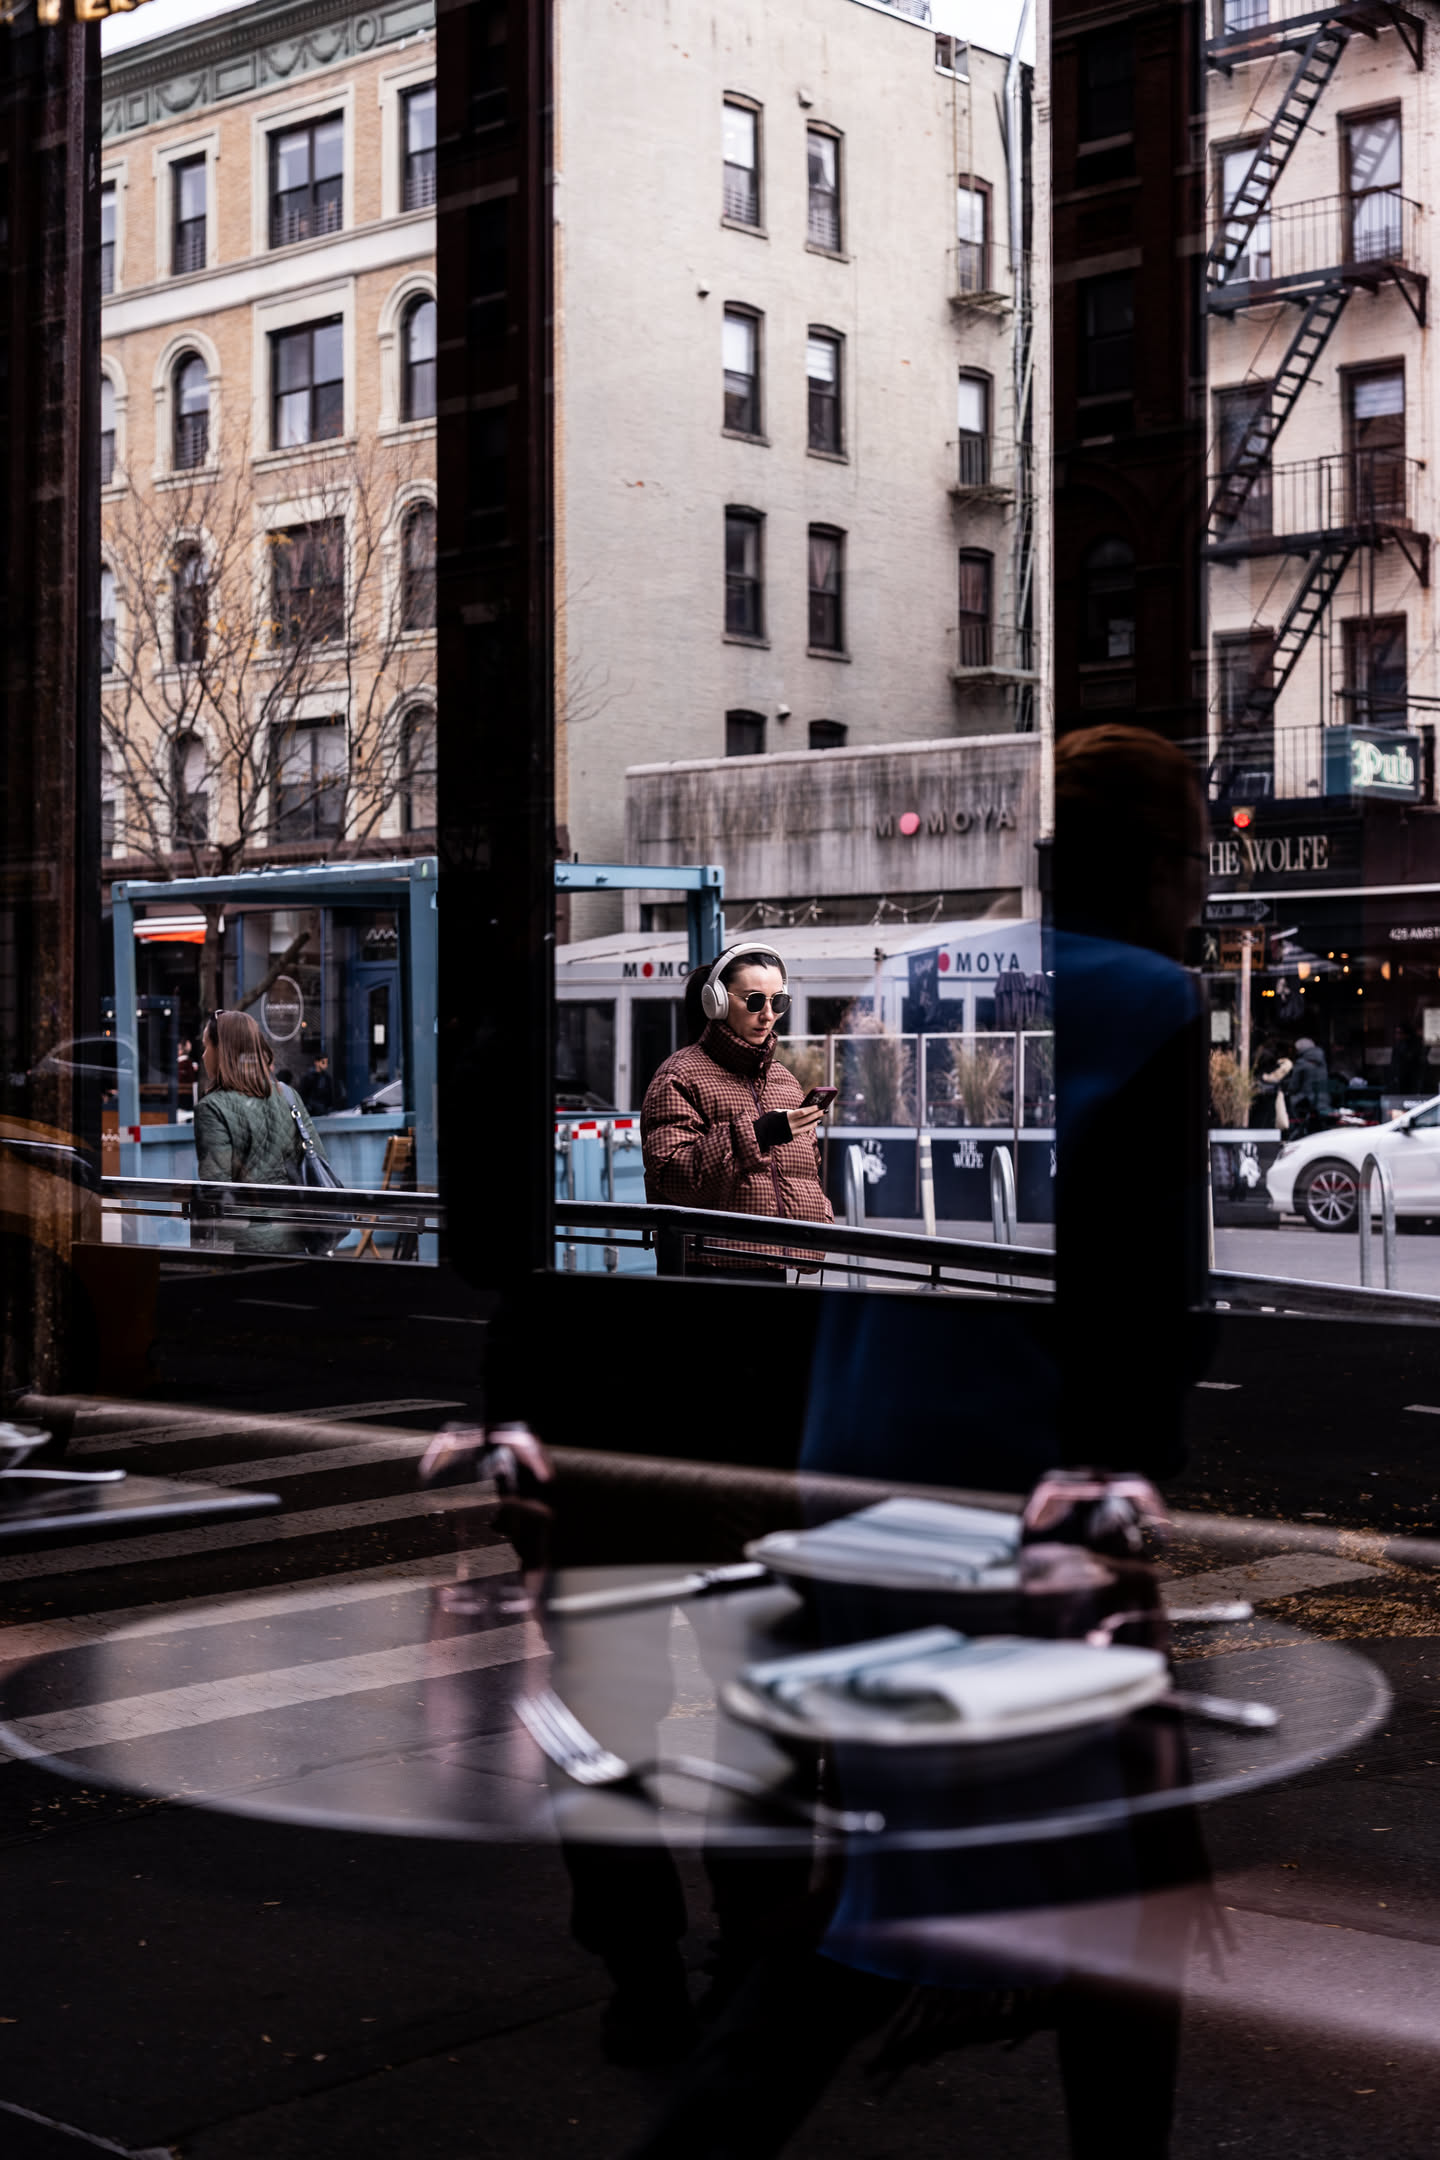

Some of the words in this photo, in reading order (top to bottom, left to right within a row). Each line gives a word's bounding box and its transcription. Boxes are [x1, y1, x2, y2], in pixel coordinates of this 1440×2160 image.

[1351, 739, 1415, 786] Pub
[875, 807, 1017, 839] MOMOYA
[1209, 840, 1241, 876] HE
[1249, 835, 1329, 873] WOLFE
[623, 961, 690, 978] MOMO
[938, 952, 1020, 973] OMOYA
[953, 1152, 984, 1169] WOLFE
